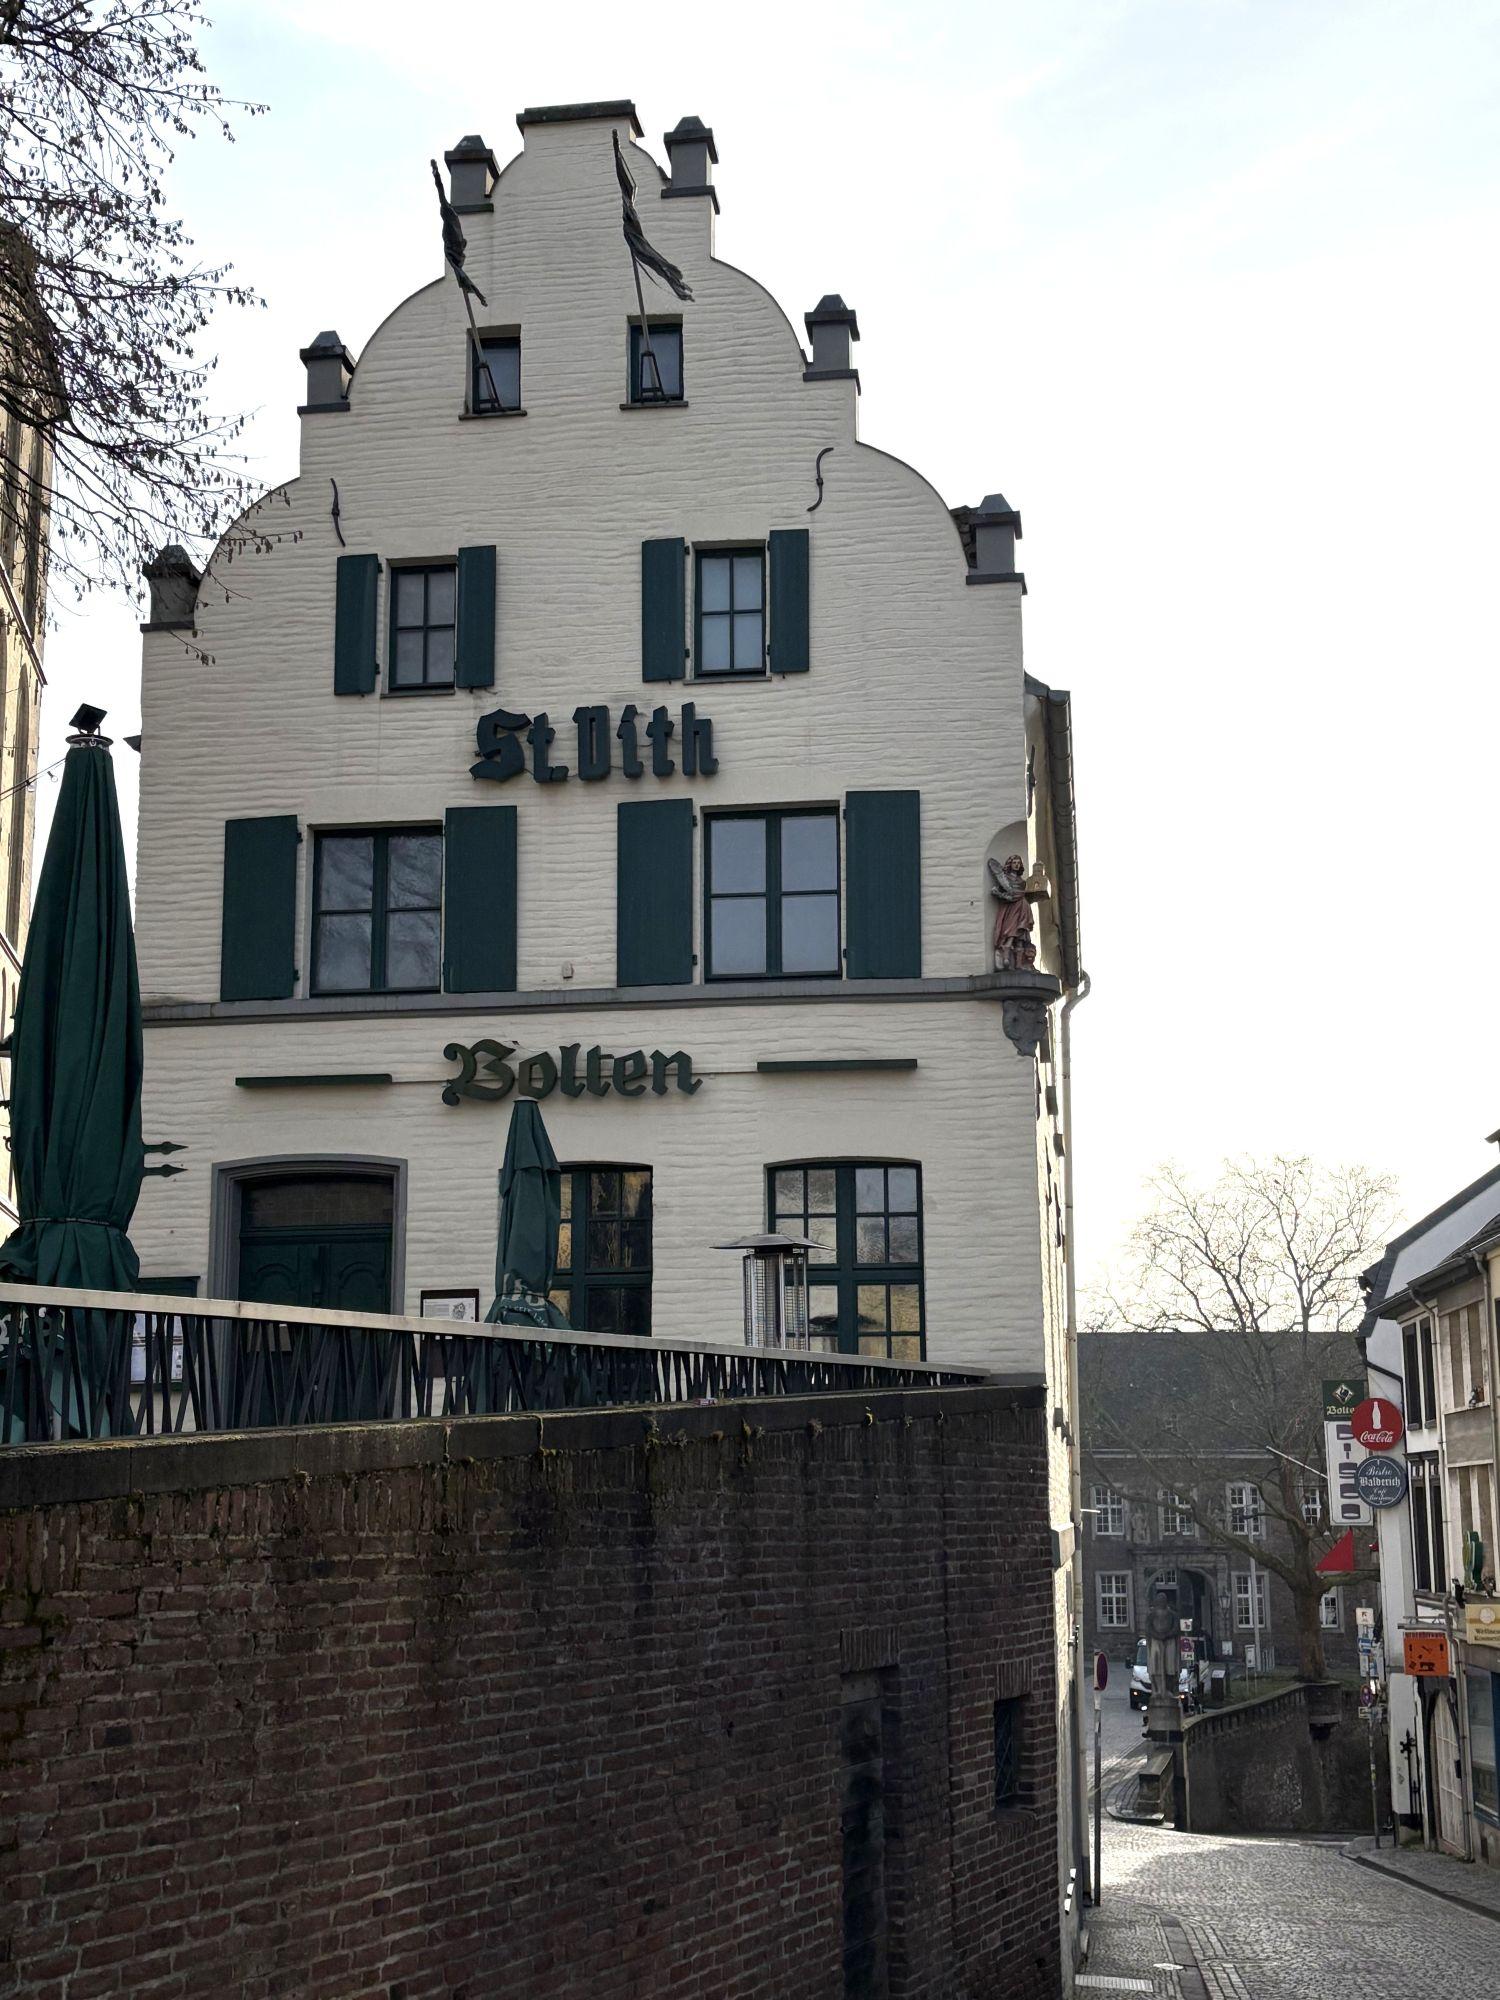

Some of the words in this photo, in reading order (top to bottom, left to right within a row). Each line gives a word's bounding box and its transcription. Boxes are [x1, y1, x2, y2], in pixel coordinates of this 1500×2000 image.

[442, 1039, 703, 1106] Bolten
[1326, 1405, 1355, 1416] Bolte
[1366, 1465, 1393, 1476] Bistro
[1360, 1476, 1401, 1487] Balderich
